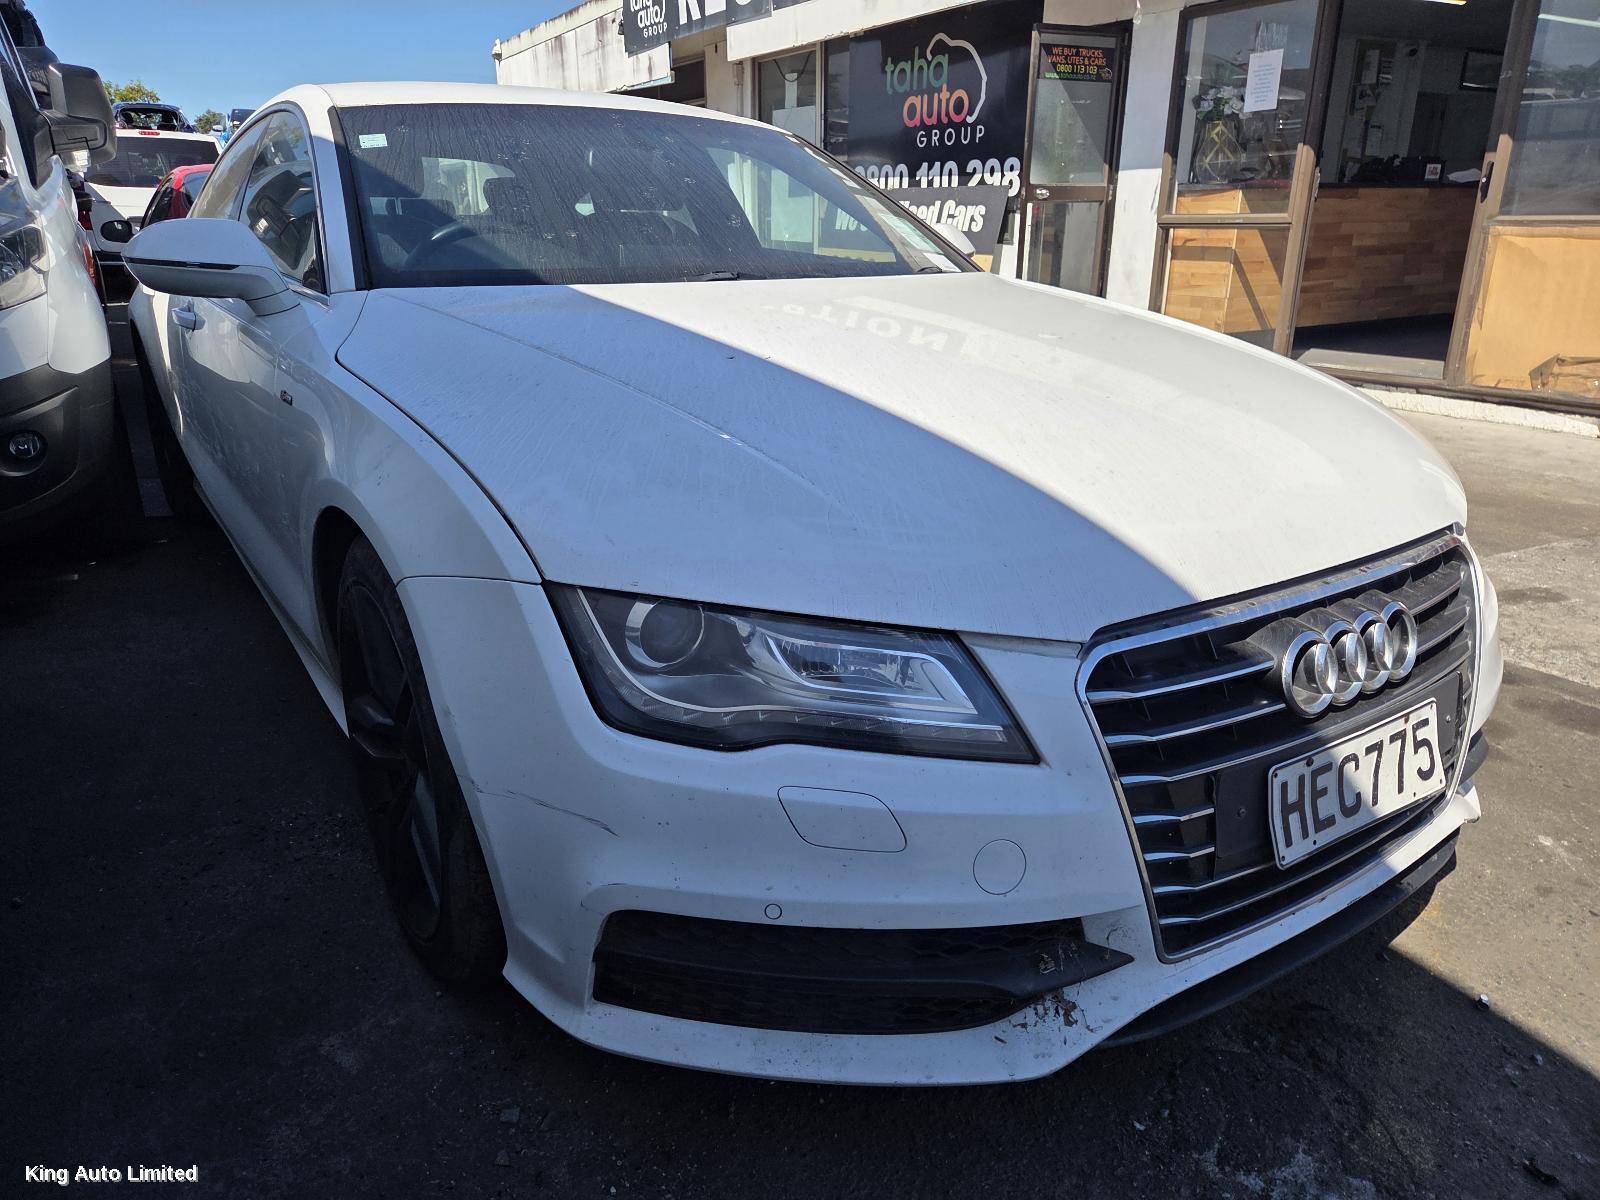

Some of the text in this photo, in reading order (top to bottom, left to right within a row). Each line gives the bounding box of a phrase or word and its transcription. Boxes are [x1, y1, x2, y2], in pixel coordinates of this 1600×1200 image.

[637, 5, 661, 28] auto
[643, 22, 668, 38] GROUP
[1052, 47, 1063, 55] WE
[1063, 48, 1076, 56] BUY
[1067, 56, 1084, 64] UTES
[1090, 58, 1107, 66] CARS
[885, 46, 949, 94] taha
[1056, 63, 1073, 73] 0800
[1073, 65, 1085, 73] 113
[1086, 65, 1098, 74] 103
[903, 83, 969, 127] auto
[916, 125, 985, 148] GROUP
[916, 160, 959, 188] 110
[966, 156, 1021, 197] 298
[940, 199, 986, 232] Cars
[1280, 717, 1436, 848] HEC775
